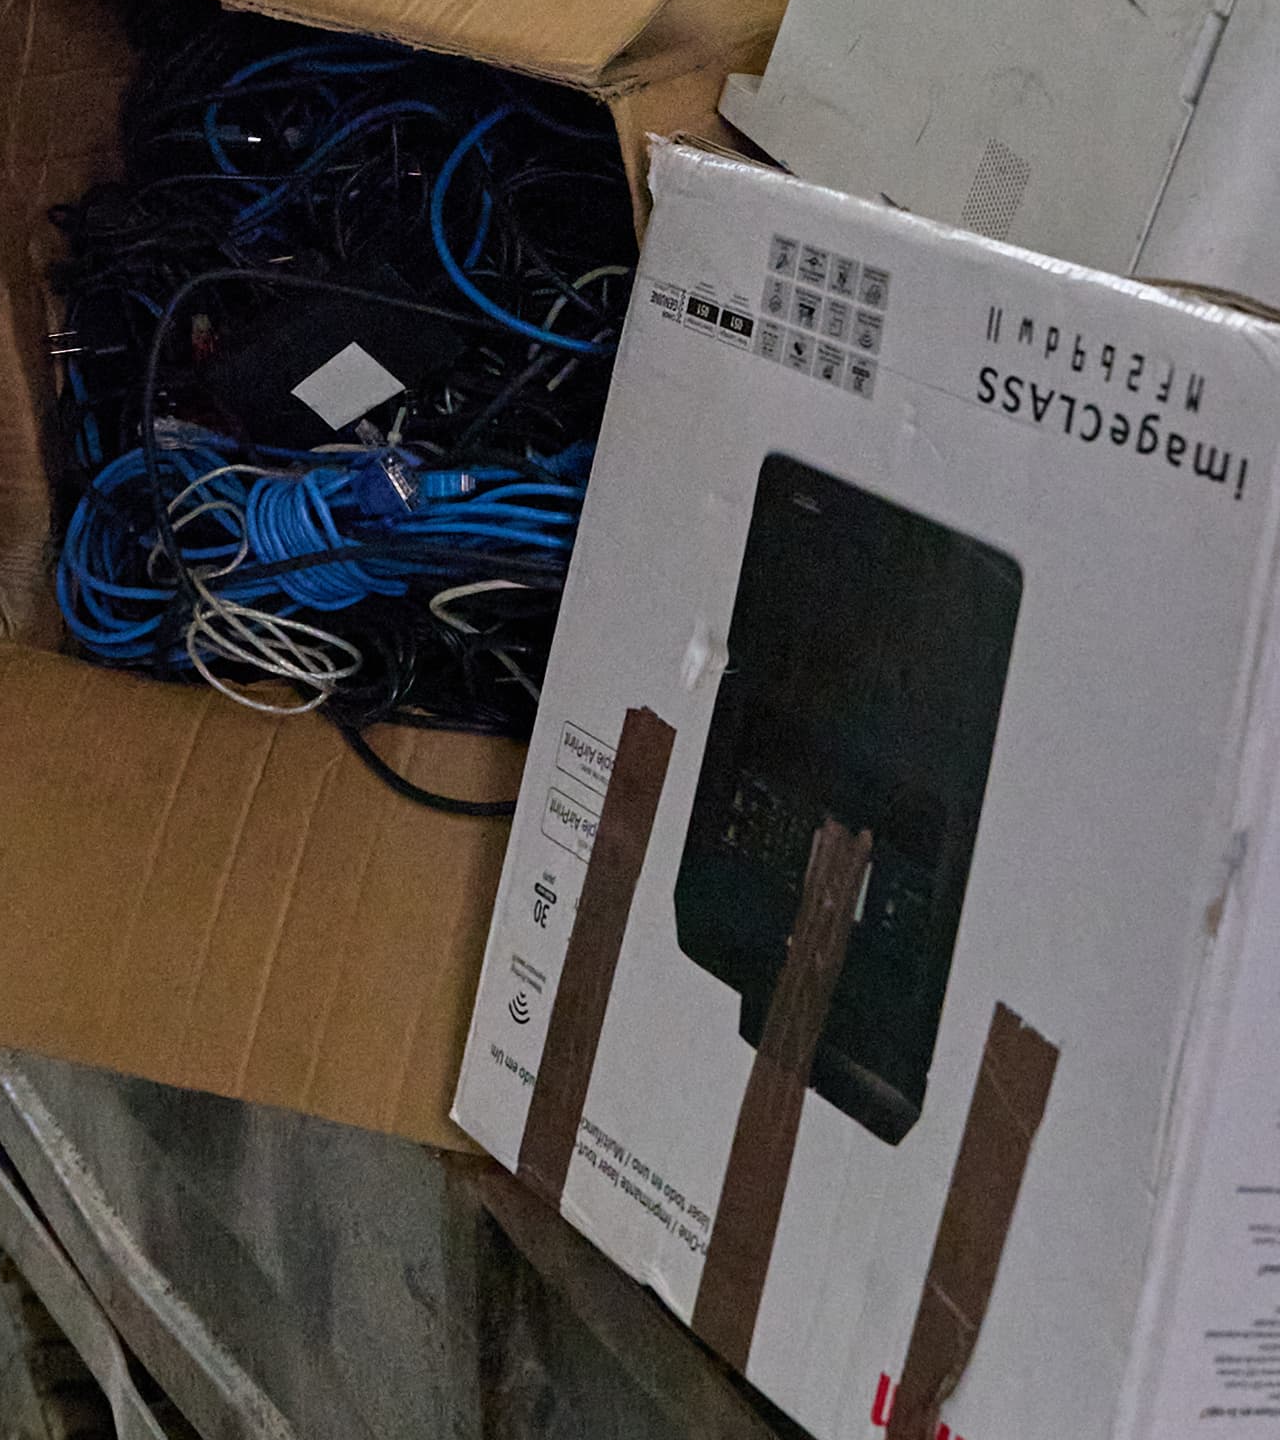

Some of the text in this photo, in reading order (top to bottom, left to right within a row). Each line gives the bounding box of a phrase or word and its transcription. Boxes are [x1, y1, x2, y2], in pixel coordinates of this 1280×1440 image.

[978, 367, 1248, 501] imageCLASS
[533, 899, 550, 929] 30
[505, 1055, 518, 1074] em
